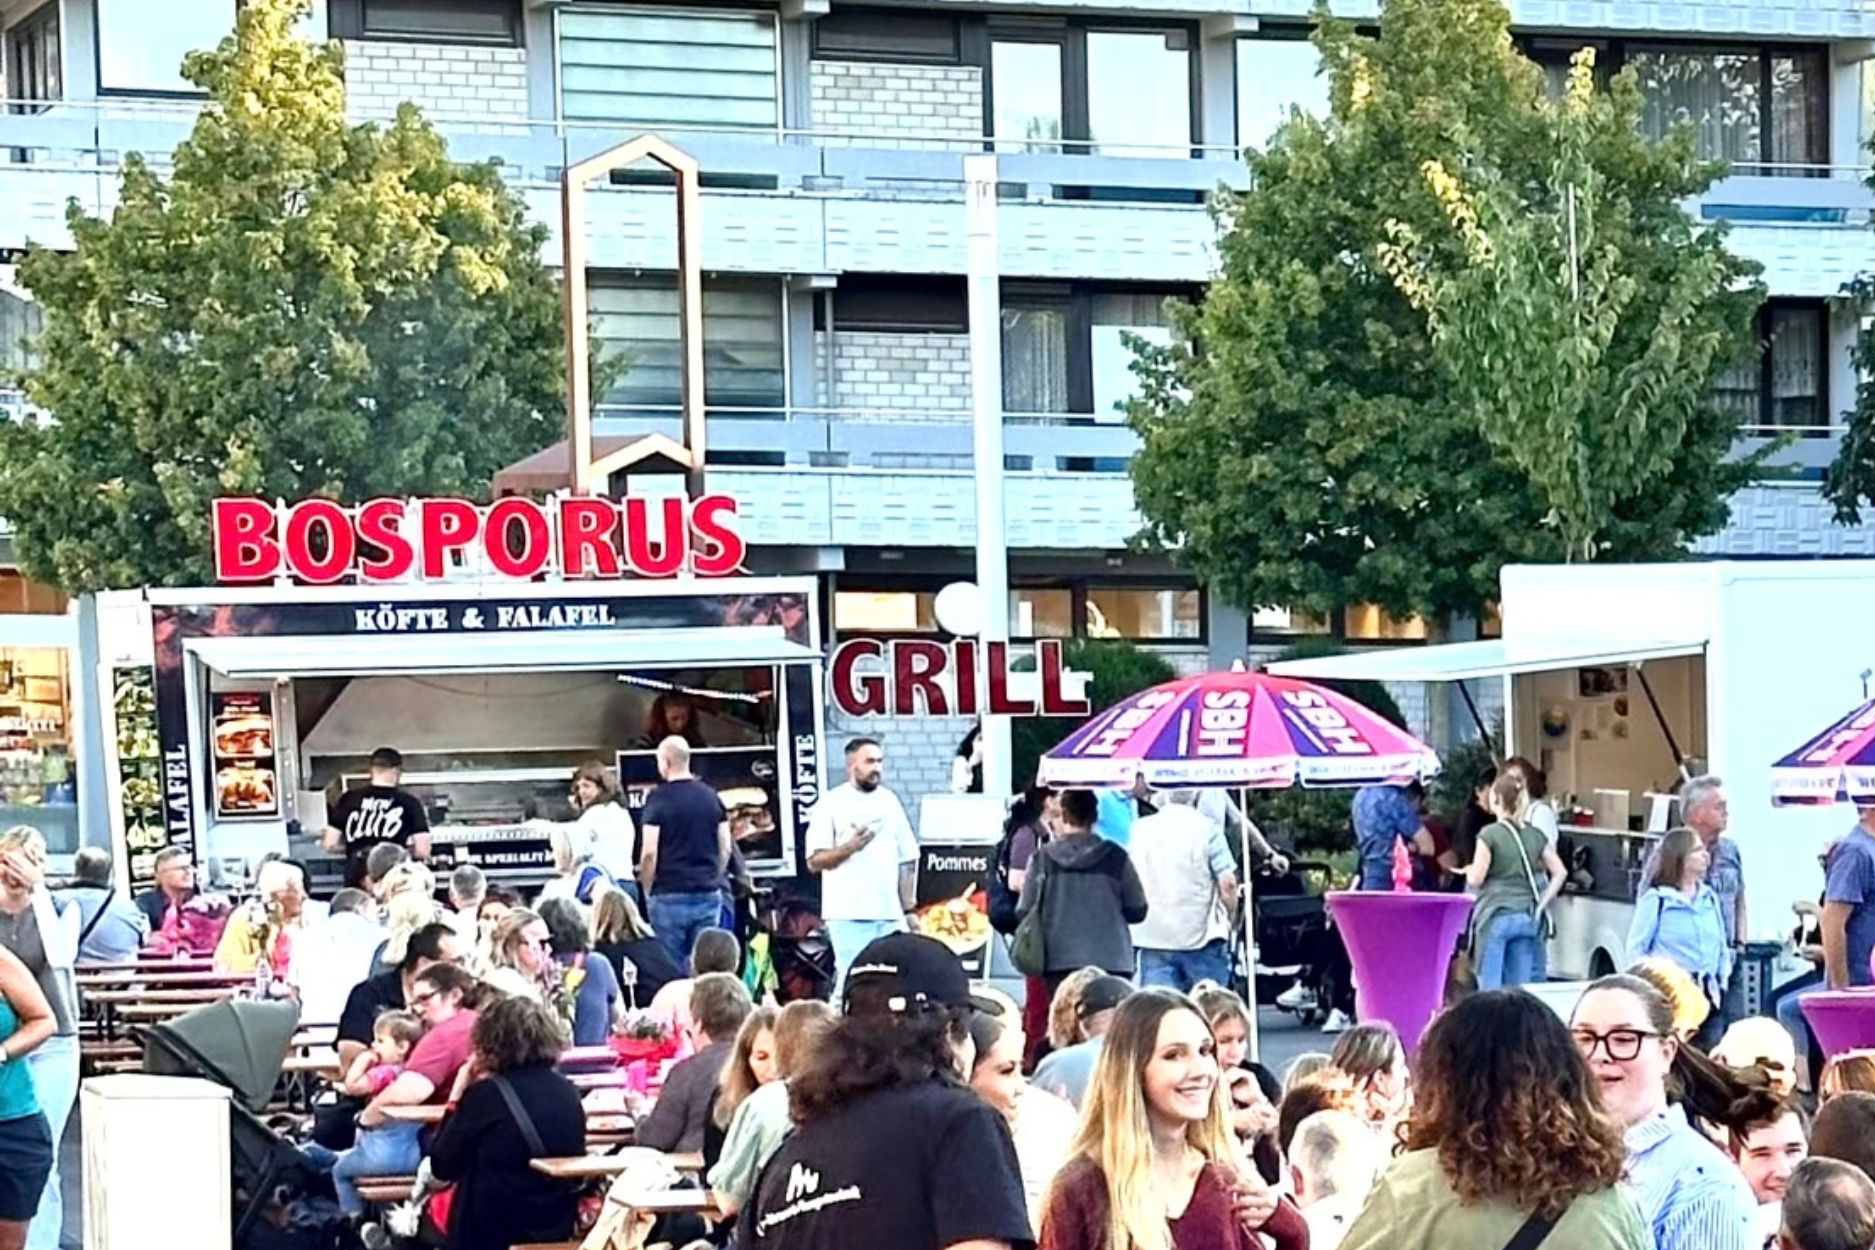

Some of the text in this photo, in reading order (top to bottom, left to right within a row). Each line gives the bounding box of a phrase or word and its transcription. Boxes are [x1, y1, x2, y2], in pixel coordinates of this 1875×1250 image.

[212, 495, 747, 585] BOSPORUS
[354, 603, 616, 631] KÖFTE & FALAFEL
[831, 638, 1092, 718] GRILL
[165, 744, 193, 853] ALAFEL
[926, 853, 988, 872] Pommes
